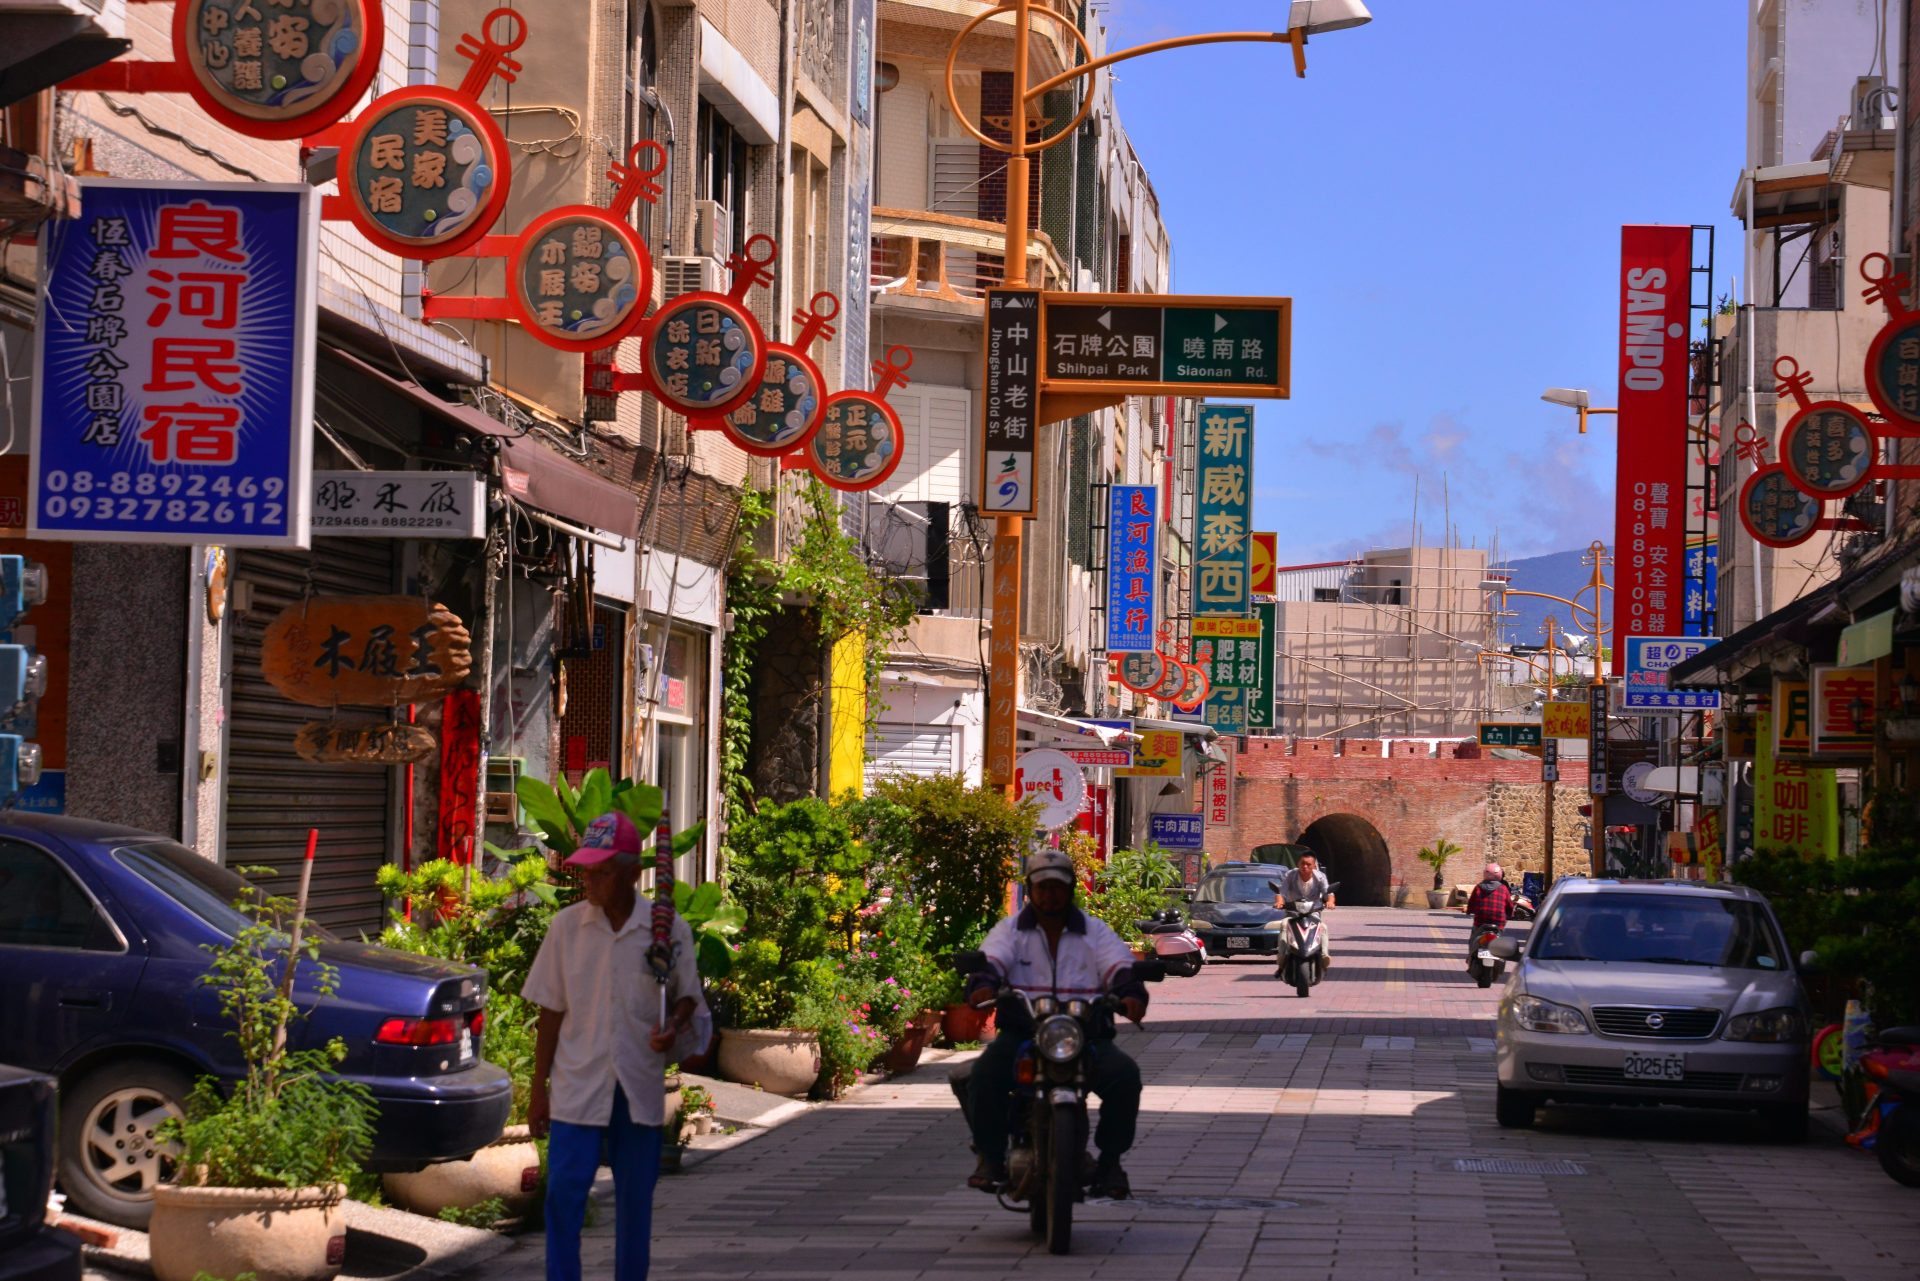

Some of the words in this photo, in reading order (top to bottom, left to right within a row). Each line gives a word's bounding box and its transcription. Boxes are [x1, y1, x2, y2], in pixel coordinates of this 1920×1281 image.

[411, 109, 447, 189] 美家
[369, 134, 405, 214] 民宿
[538, 238, 566, 328] 木屐王
[991, 297, 1002, 309] 西
[1022, 297, 1037, 309] W.
[82, 217, 132, 446] 恆春石牌公園店
[140, 202, 247, 462] 良河民宿
[695, 309, 721, 367] 日新
[1053, 334, 1155, 358] 石牌公園
[1183, 337, 1264, 360] 曉南路
[1624, 267, 1667, 391] SAMPO
[666, 320, 691, 398] 洗衣店
[989, 328, 1002, 393] Jhongshan
[1004, 322, 1029, 440] 中山老街
[1057, 362, 1108, 376] Shihpai
[1117, 363, 1149, 376] Park
[1177, 365, 1232, 378] Siaonan
[1246, 366, 1268, 378] Rd.
[846, 405, 868, 450] 正元
[990, 394, 999, 418] Old
[990, 421, 1000, 438] St.
[46, 470, 285, 499] 08-8892469
[1650, 482, 1669, 529] 聲寶
[45, 495, 283, 525] 0932782612
[382, 517, 443, 527] 8882229
[1200, 414, 1248, 617] 新威森西
[1125, 489, 1152, 633] 良河漁具行
[1648, 545, 1668, 633] 安全電器
[314, 623, 442, 679] 木屐王
[1216, 639, 1235, 684] 肥料
[1239, 640, 1257, 685] 資材
[1631, 694, 1714, 707] 安全電器行
[1152, 733, 1179, 758] 麵
[1154, 819, 1202, 833] 牛肉河粉
